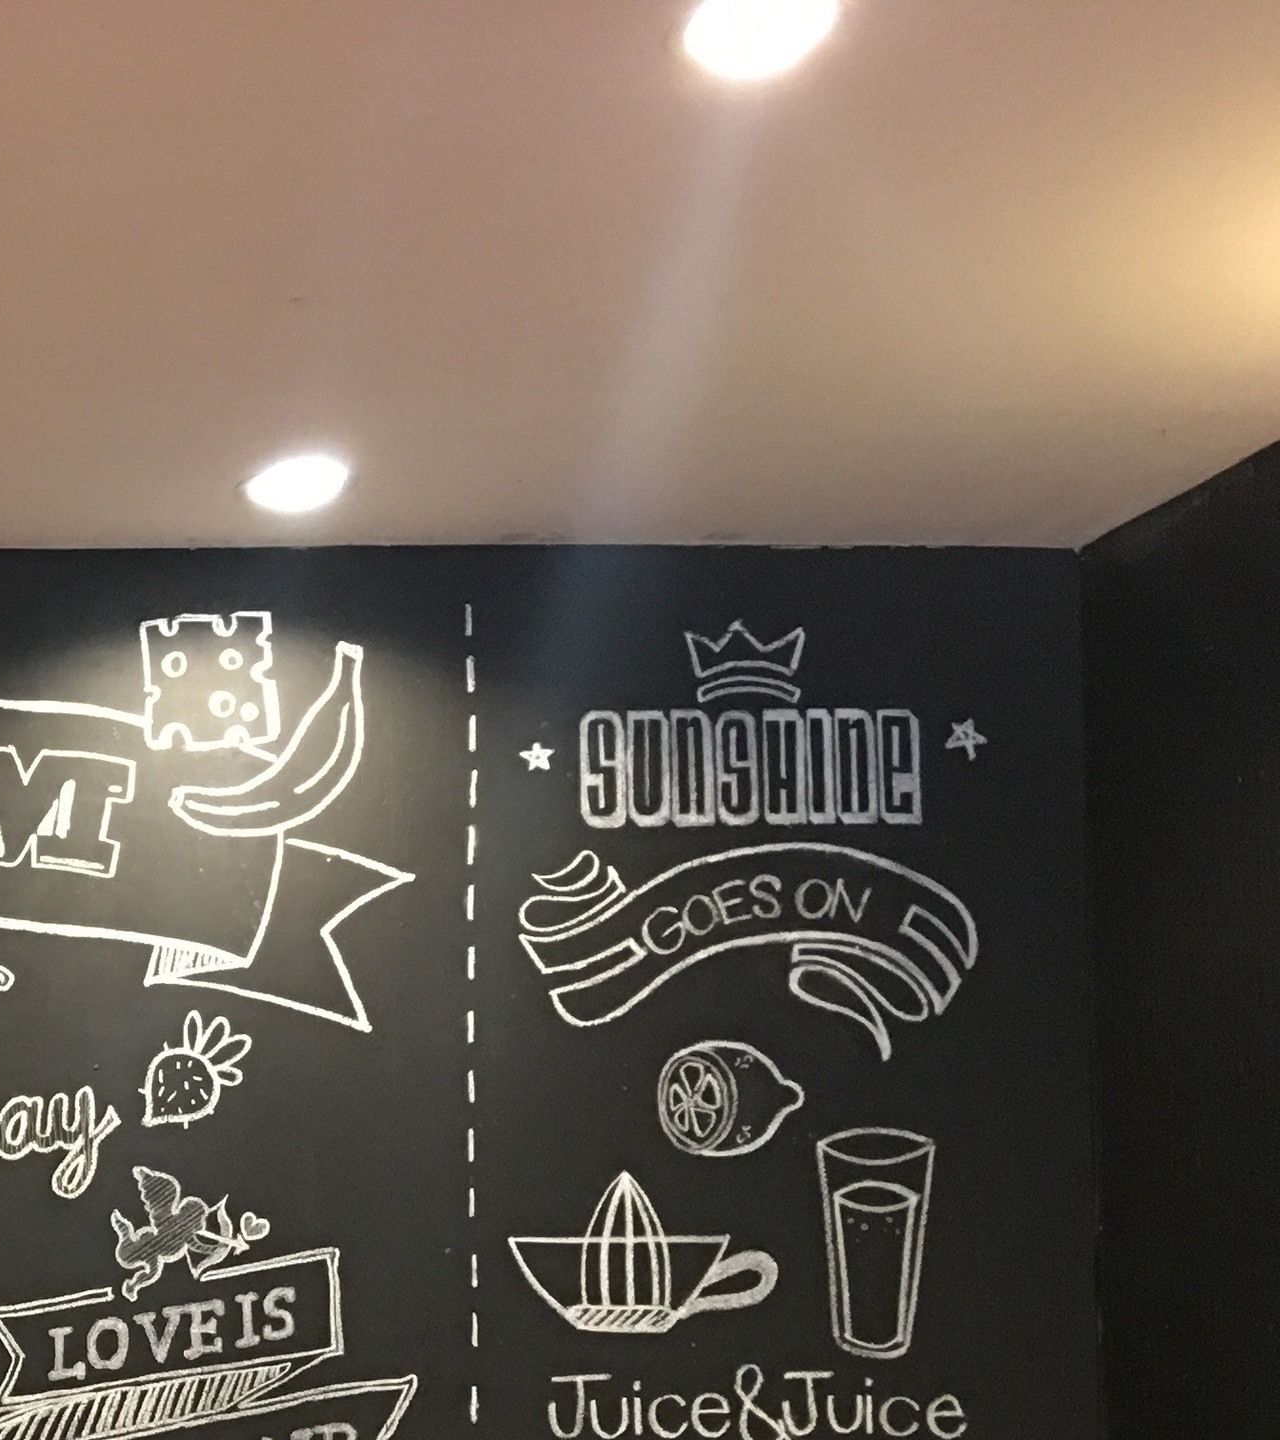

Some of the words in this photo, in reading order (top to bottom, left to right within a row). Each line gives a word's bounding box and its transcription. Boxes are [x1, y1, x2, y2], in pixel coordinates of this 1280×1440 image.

[642, 874, 783, 955] GOES
[795, 878, 873, 923] ON
[47, 1302, 225, 1382] LOVE
[235, 1285, 296, 1348] IS
